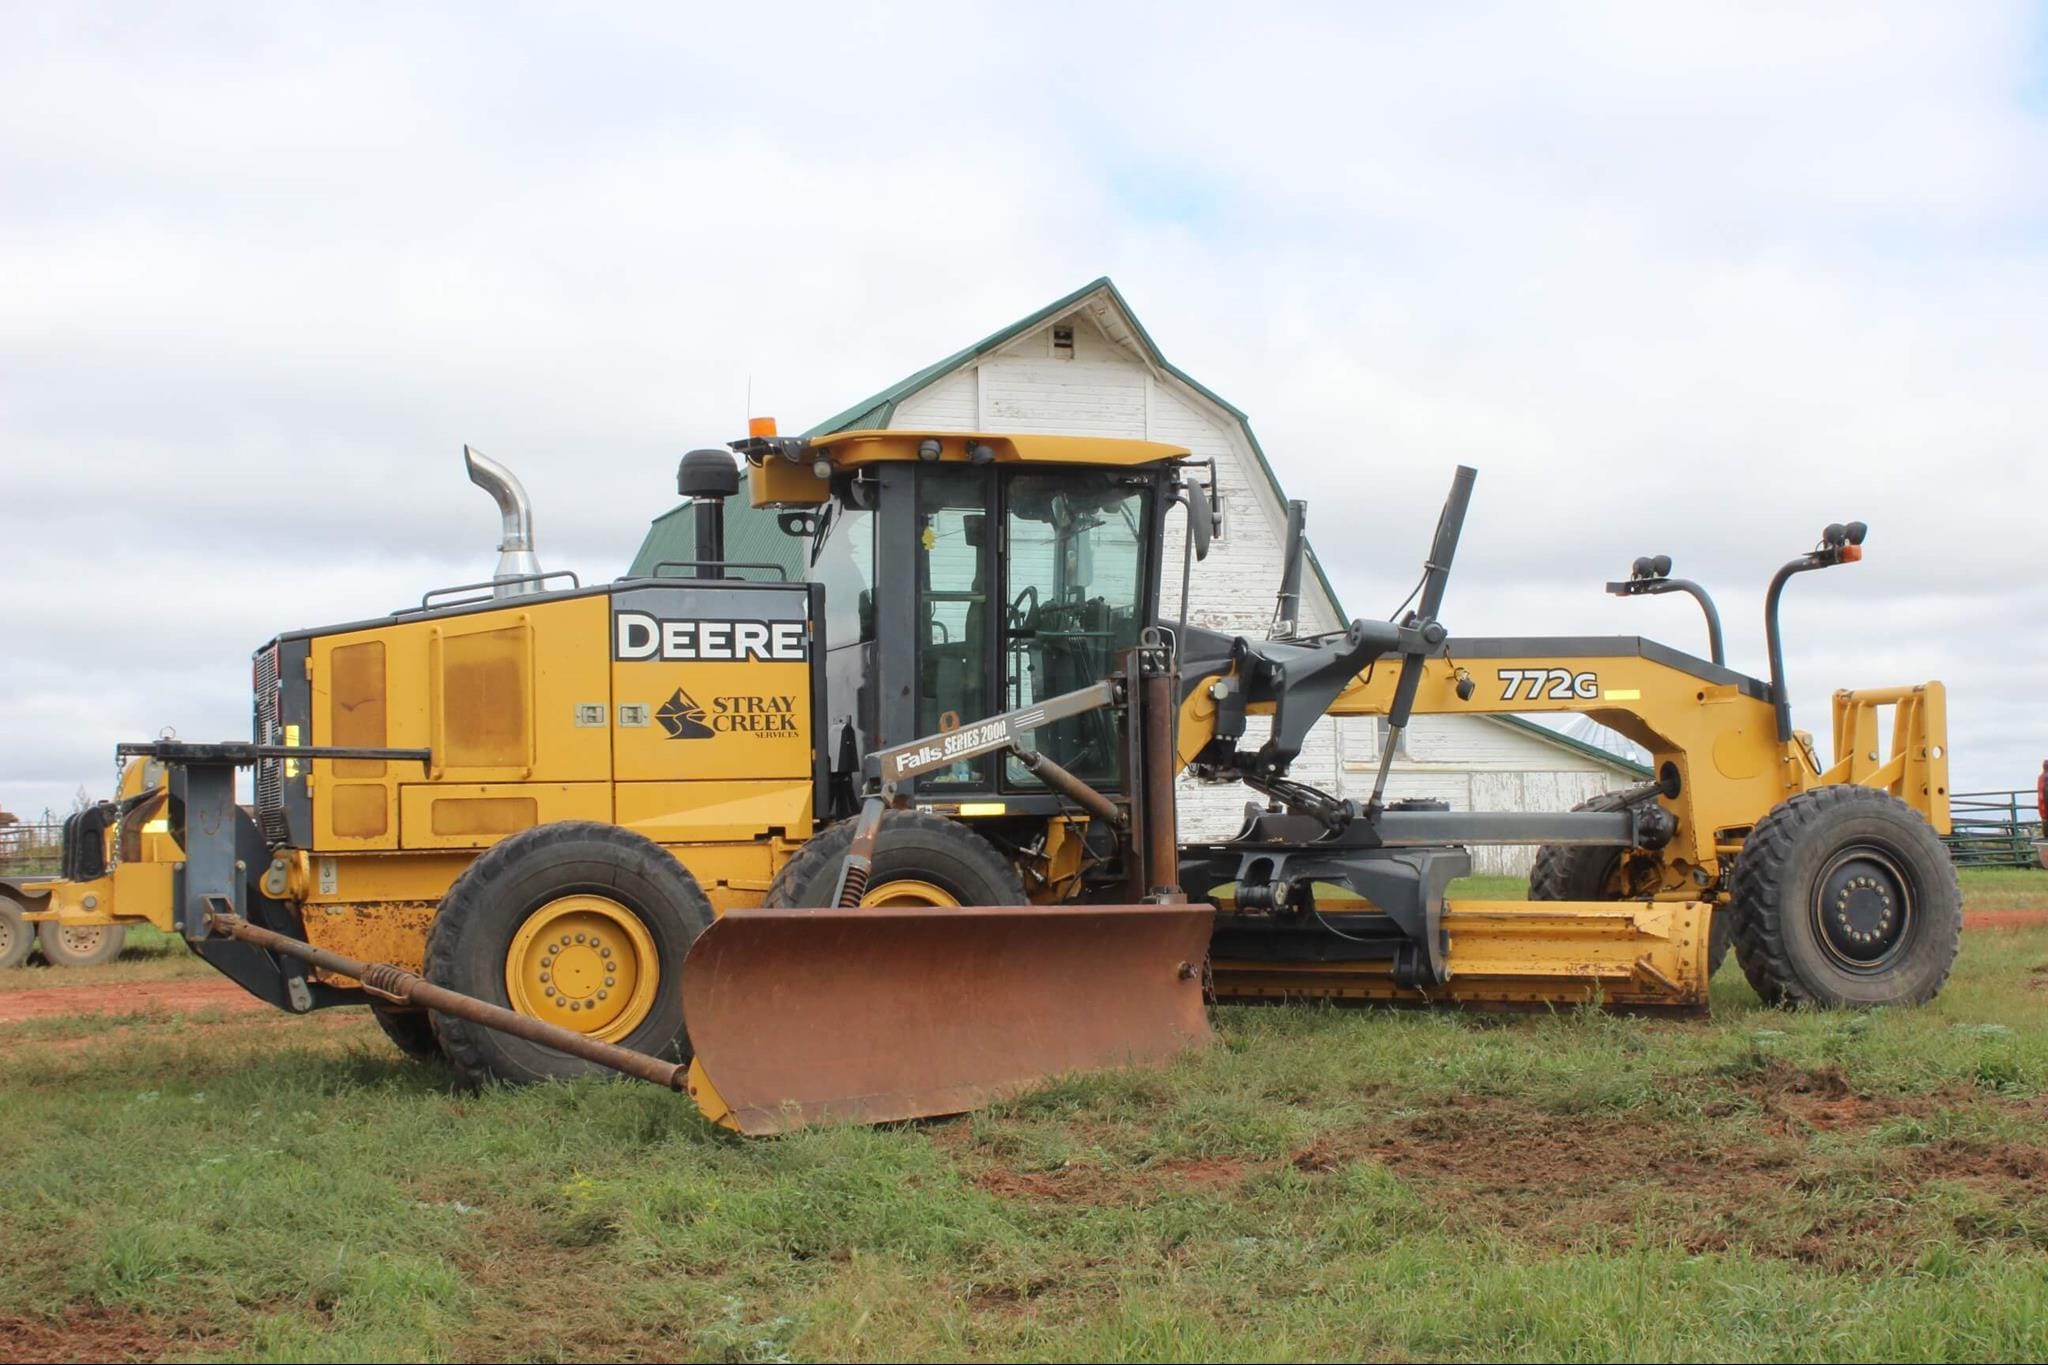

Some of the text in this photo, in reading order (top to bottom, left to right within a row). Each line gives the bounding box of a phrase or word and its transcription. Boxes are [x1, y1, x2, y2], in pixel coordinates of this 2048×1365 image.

[615, 611, 806, 660] DEERE
[1498, 668, 1598, 699] 772G
[712, 696, 796, 714] STRAY
[712, 714, 798, 732] CREEK
[754, 731, 800, 739] SERVICES
[895, 720, 1006, 772] Falls SERIES 2000
